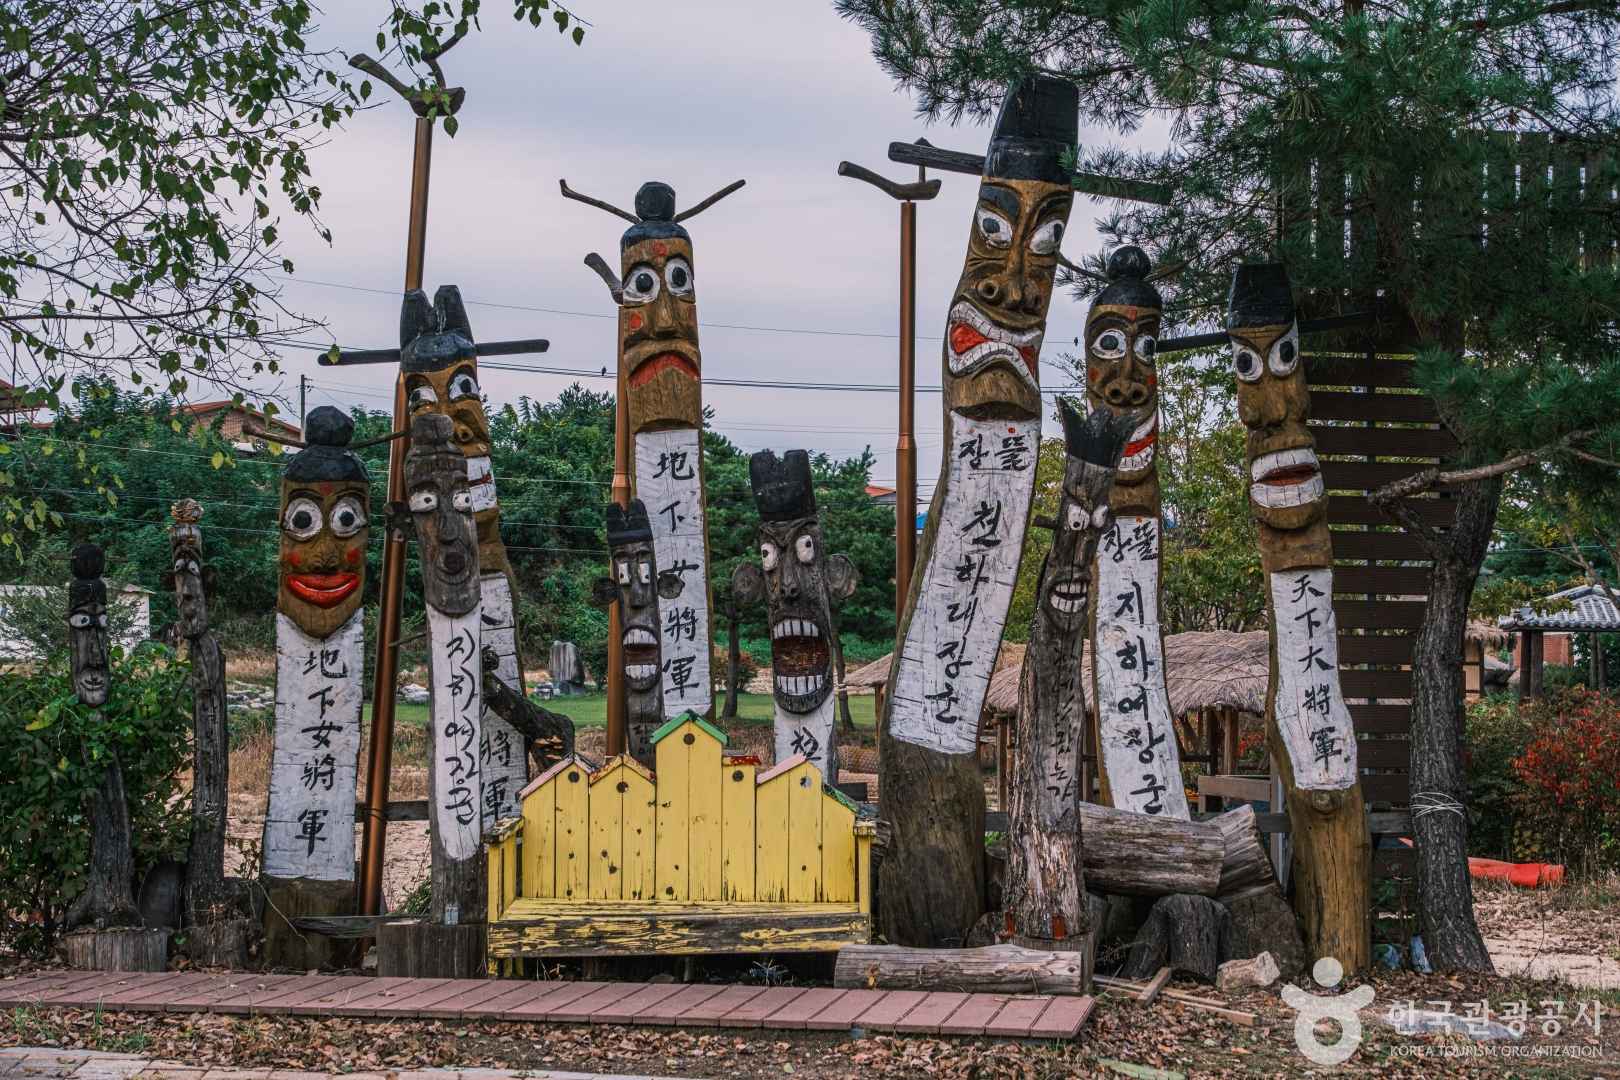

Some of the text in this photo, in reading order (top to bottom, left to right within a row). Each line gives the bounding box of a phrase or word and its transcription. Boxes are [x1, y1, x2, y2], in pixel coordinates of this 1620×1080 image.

[295, 649, 348, 858] 地下女將軍
[1115, 581, 1167, 815] 지하여장군
[1291, 574, 1342, 772] 天下大將軍
